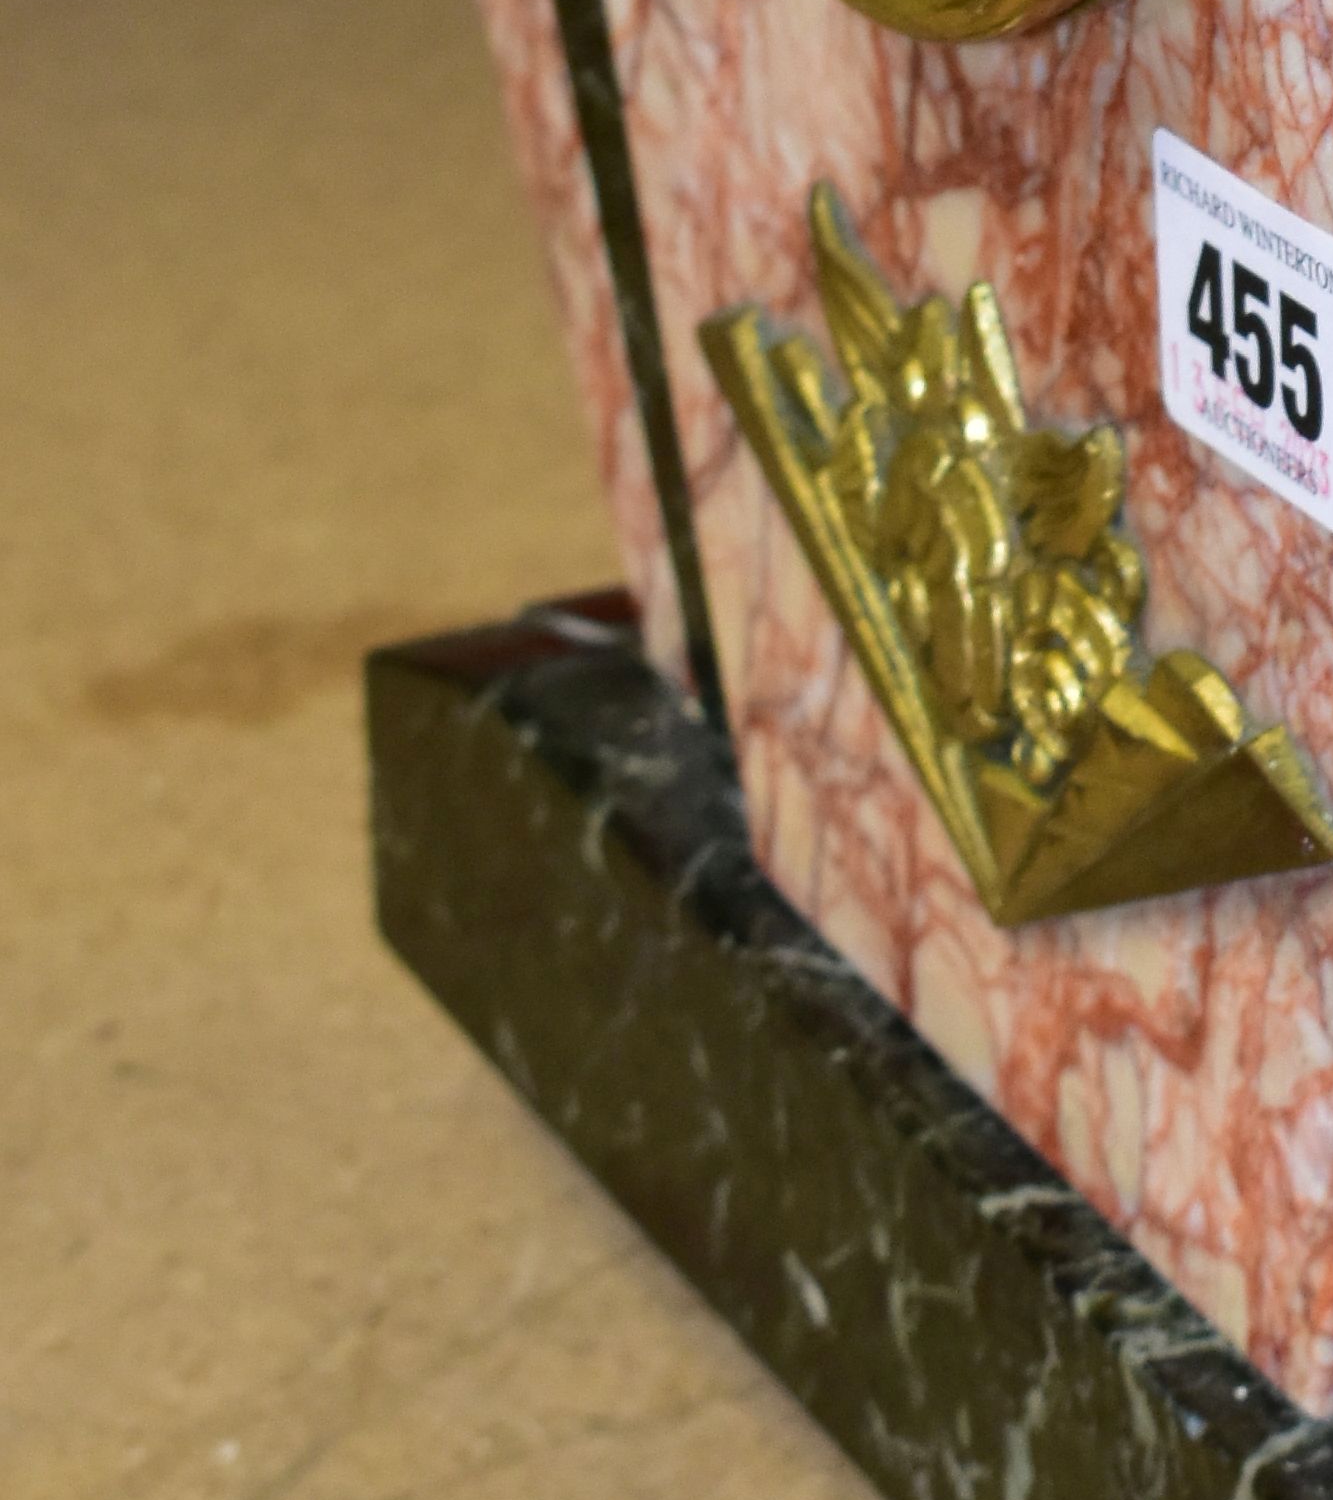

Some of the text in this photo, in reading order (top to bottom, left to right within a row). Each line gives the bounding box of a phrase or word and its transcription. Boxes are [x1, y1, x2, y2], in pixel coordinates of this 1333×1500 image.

[1160, 160, 1236, 228] RICHARD
[1187, 240, 1323, 442] 455
[1201, 396, 1318, 495] AUCTIONEERS
